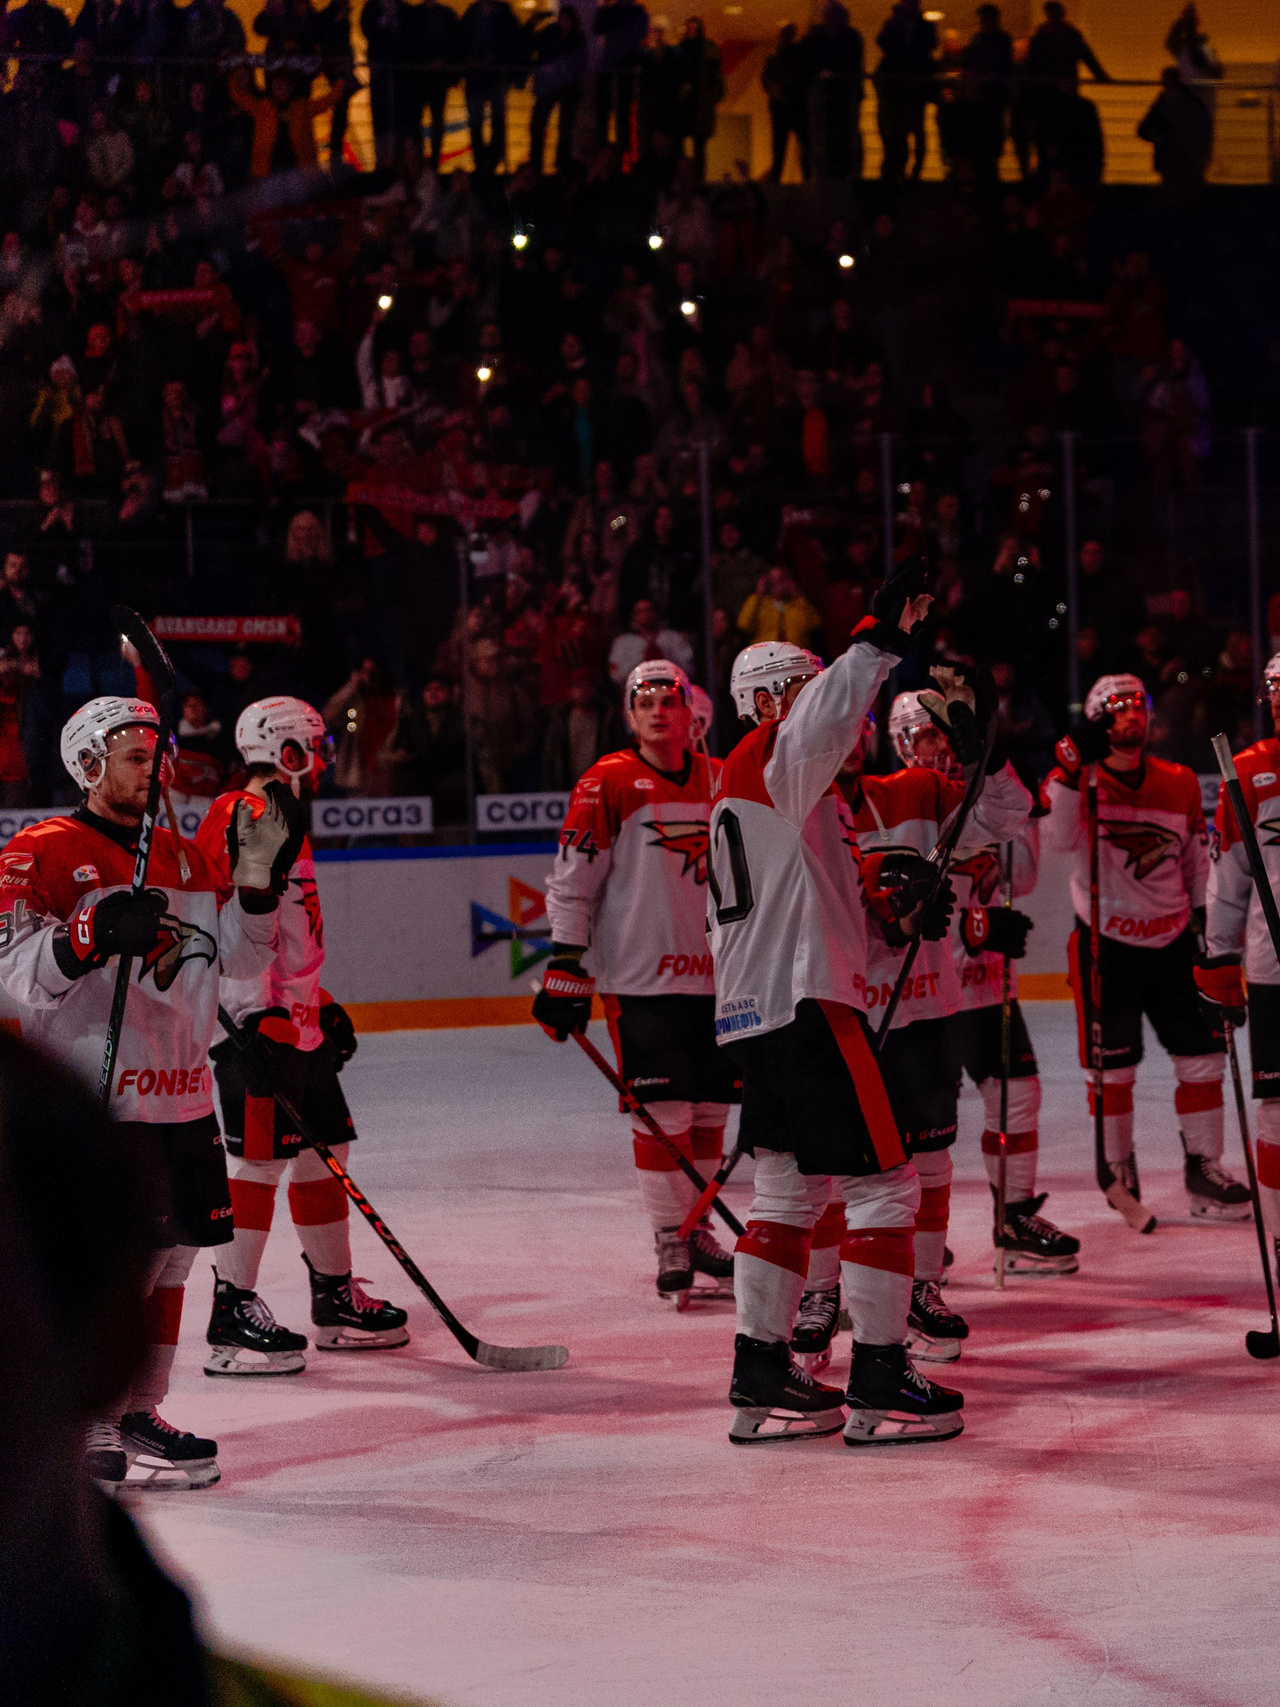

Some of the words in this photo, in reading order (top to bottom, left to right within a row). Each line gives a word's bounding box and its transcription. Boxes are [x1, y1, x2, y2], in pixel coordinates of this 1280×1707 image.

[486, 801, 565, 823] сога
[561, 829, 599, 864] 74
[0, 874, 29, 887] RIVE
[864, 971, 941, 1010] ONBET
[116, 1064, 207, 1096] FONBE
